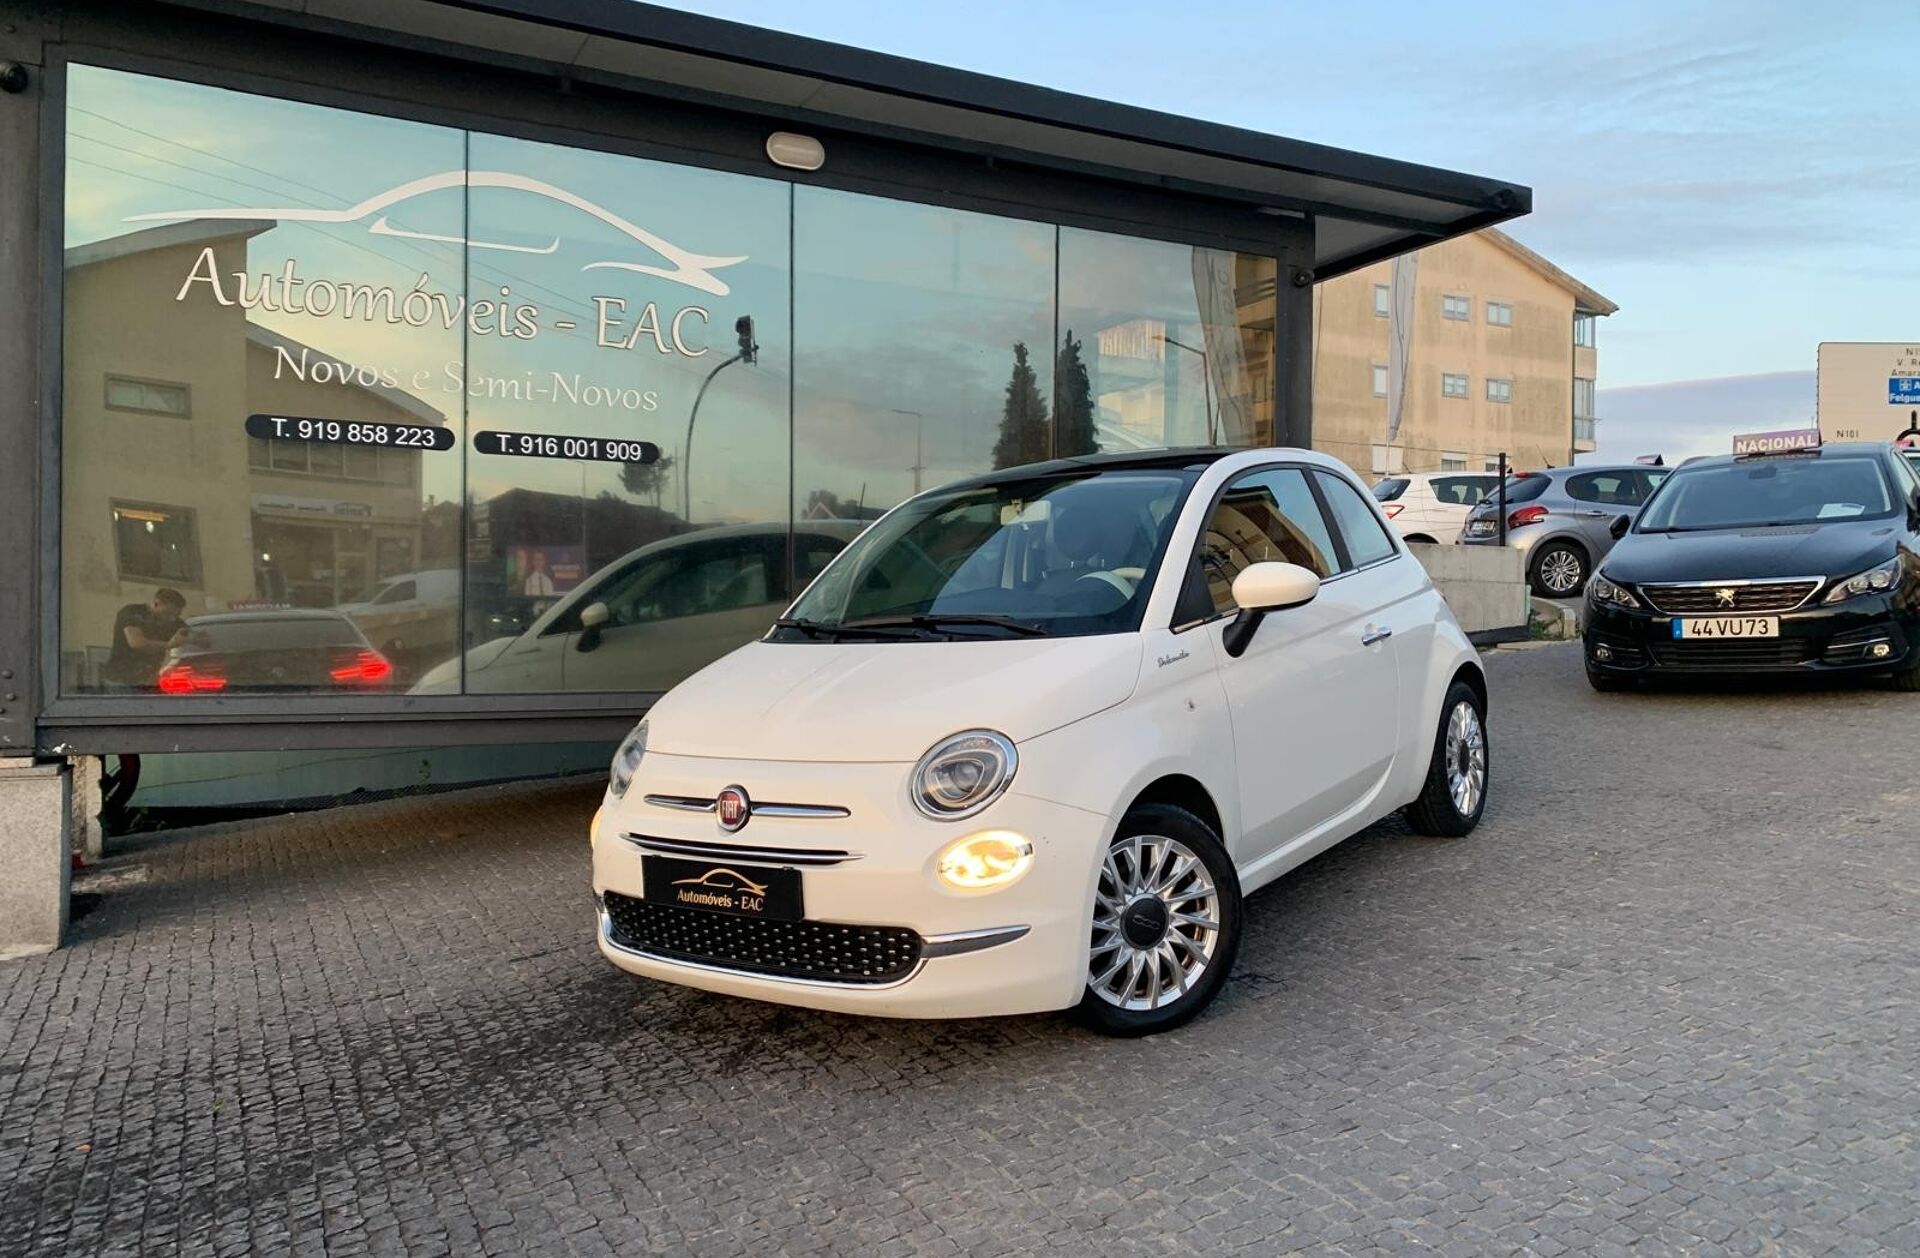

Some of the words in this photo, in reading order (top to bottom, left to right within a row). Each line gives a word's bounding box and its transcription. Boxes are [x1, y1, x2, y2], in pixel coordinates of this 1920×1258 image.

[176, 247, 538, 340] Automóveis
[591, 296, 709, 357] EAC
[273, 345, 399, 389] Novos
[412, 368, 431, 391] e
[443, 360, 659, 412] Semi-Novos
[271, 417, 290, 438] T.
[298, 420, 341, 441] 919
[347, 423, 389, 444] 858
[395, 426, 436, 447] 223
[1736, 434, 1817, 453] NACIONAL
[496, 434, 514, 454] T.
[520, 436, 558, 457] 916
[563, 438, 598, 459] 001
[606, 442, 642, 462] 909
[722, 800, 738, 818] FIAT
[678, 890, 732, 907] Automóveis
[741, 896, 763, 911] EAC
